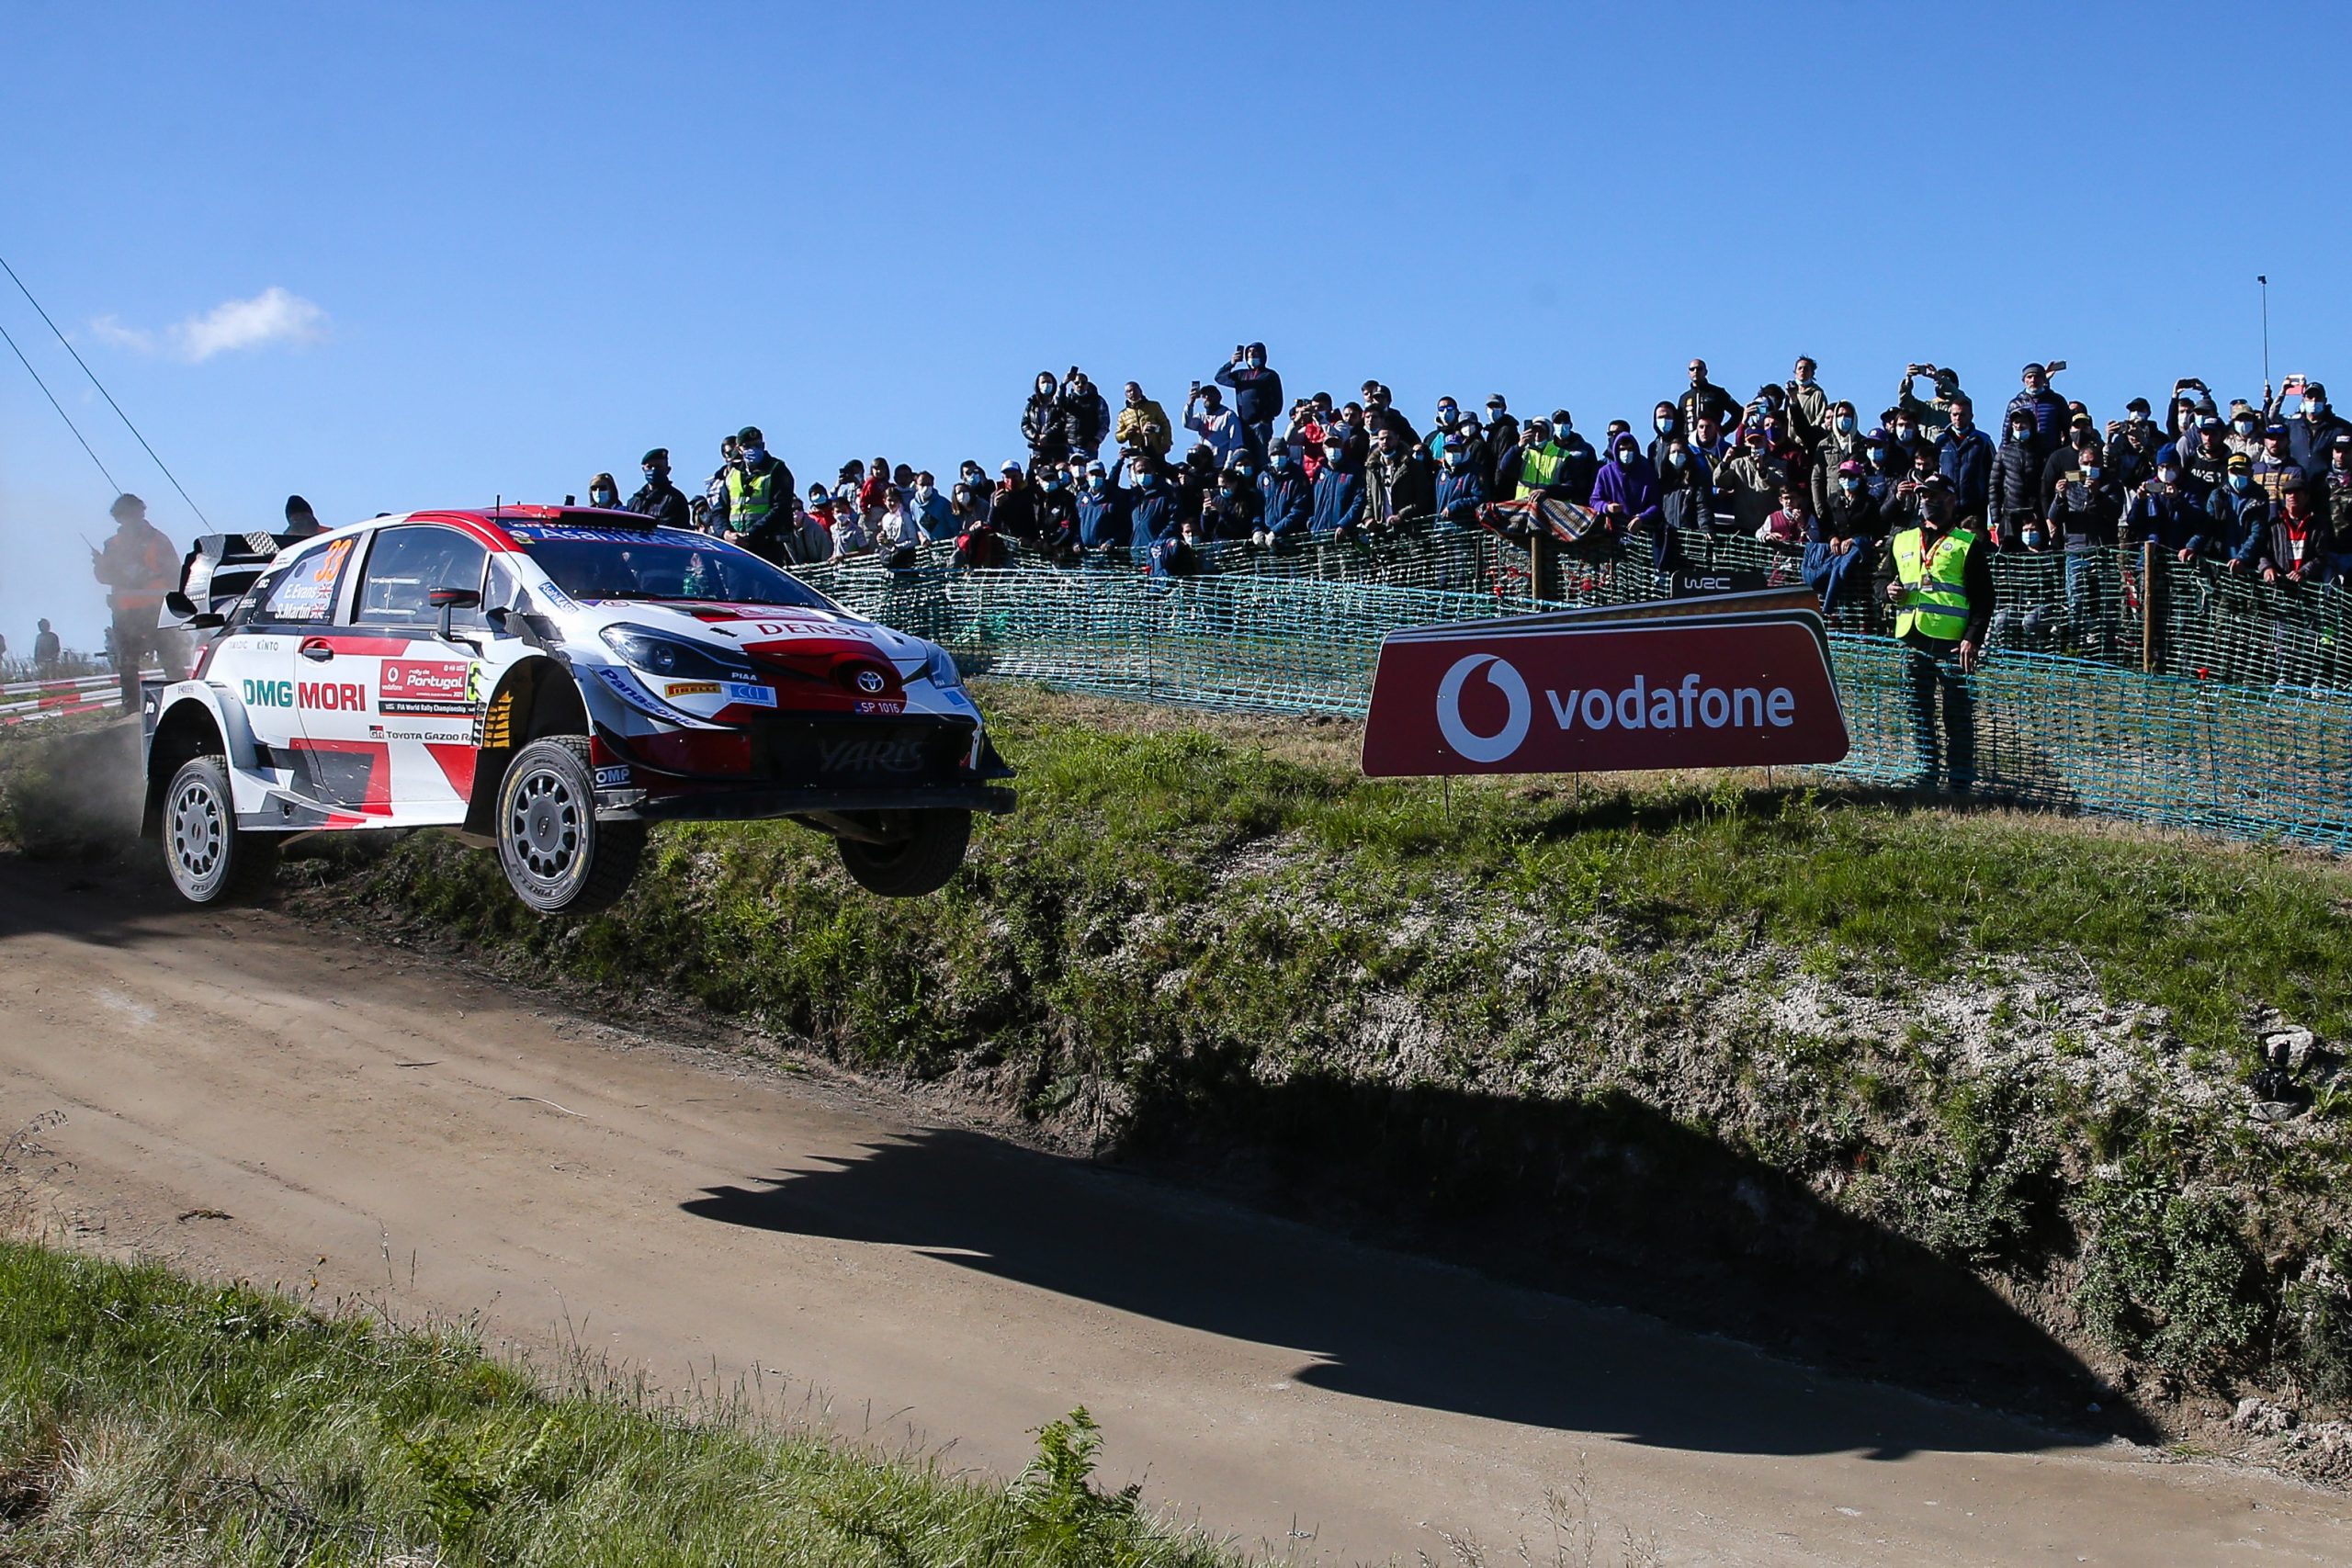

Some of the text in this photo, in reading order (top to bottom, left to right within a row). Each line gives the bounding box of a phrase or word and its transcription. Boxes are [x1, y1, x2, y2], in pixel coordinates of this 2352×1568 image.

[314, 539, 352, 581] 33
[284, 583, 318, 599] E.Evans
[1684, 577, 1731, 590] WRC
[275, 603, 311, 619] S.Martin
[755, 624, 873, 639] DENSO
[407, 675, 463, 690] Portugal
[731, 671, 758, 682] PIAA
[243, 679, 367, 712] DMG MORI
[599, 668, 698, 727] Panasonic
[1544, 673, 1795, 730] vodafone
[861, 702, 900, 714] SP 1016
[369, 730, 384, 739] GR
[387, 730, 423, 740] TOYOTA
[424, 731, 459, 741] GAZOO
[595, 768, 631, 784] OMP
